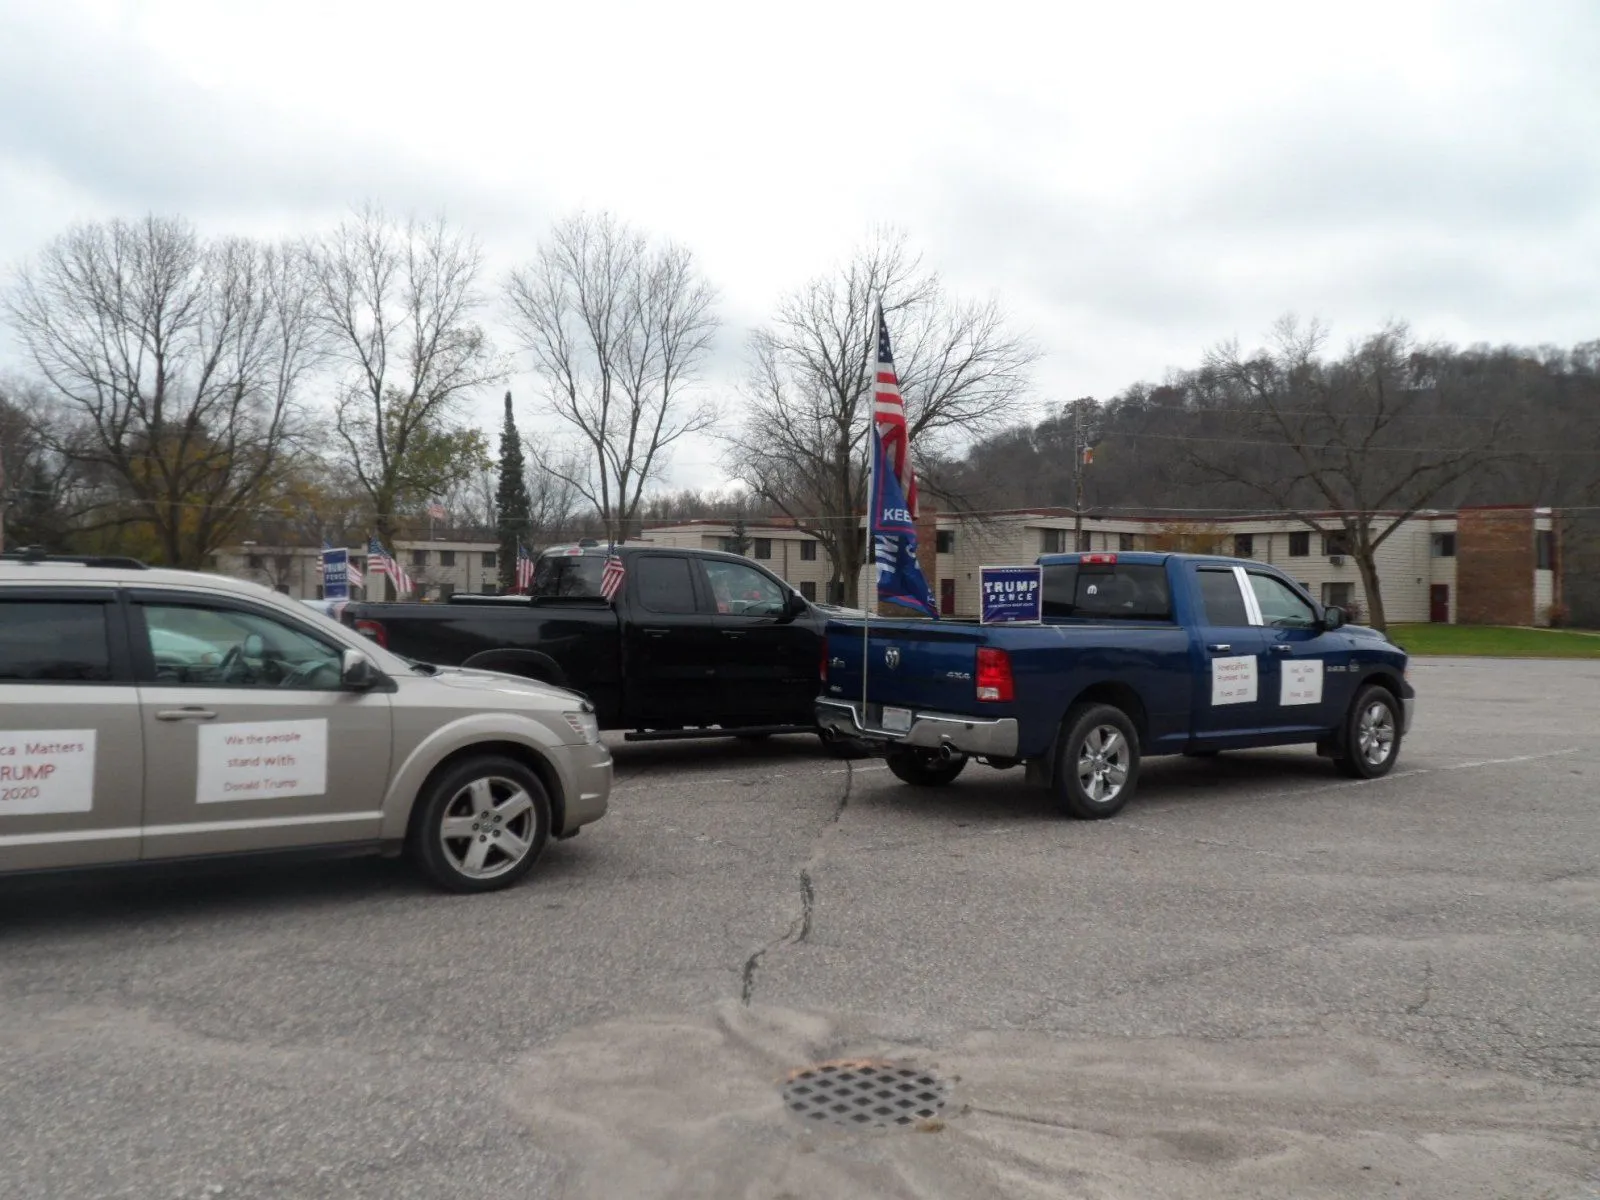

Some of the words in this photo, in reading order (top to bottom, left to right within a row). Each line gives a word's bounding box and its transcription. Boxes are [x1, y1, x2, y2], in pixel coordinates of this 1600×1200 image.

[984, 580, 1038, 593] TRUMP
[989, 593, 1033, 602] PENCE
[225, 735, 244, 745] We
[246, 734, 263, 744] the
[265, 732, 301, 744] people
[0, 745, 16, 756] ca
[25, 742, 84, 755] Matters
[226, 756, 259, 768] stand
[263, 754, 297, 766] with
[0, 764, 56, 781] RUMP
[224, 780, 259, 792] Donald
[263, 778, 297, 790] Trump
[1, 786, 40, 801] 2020
